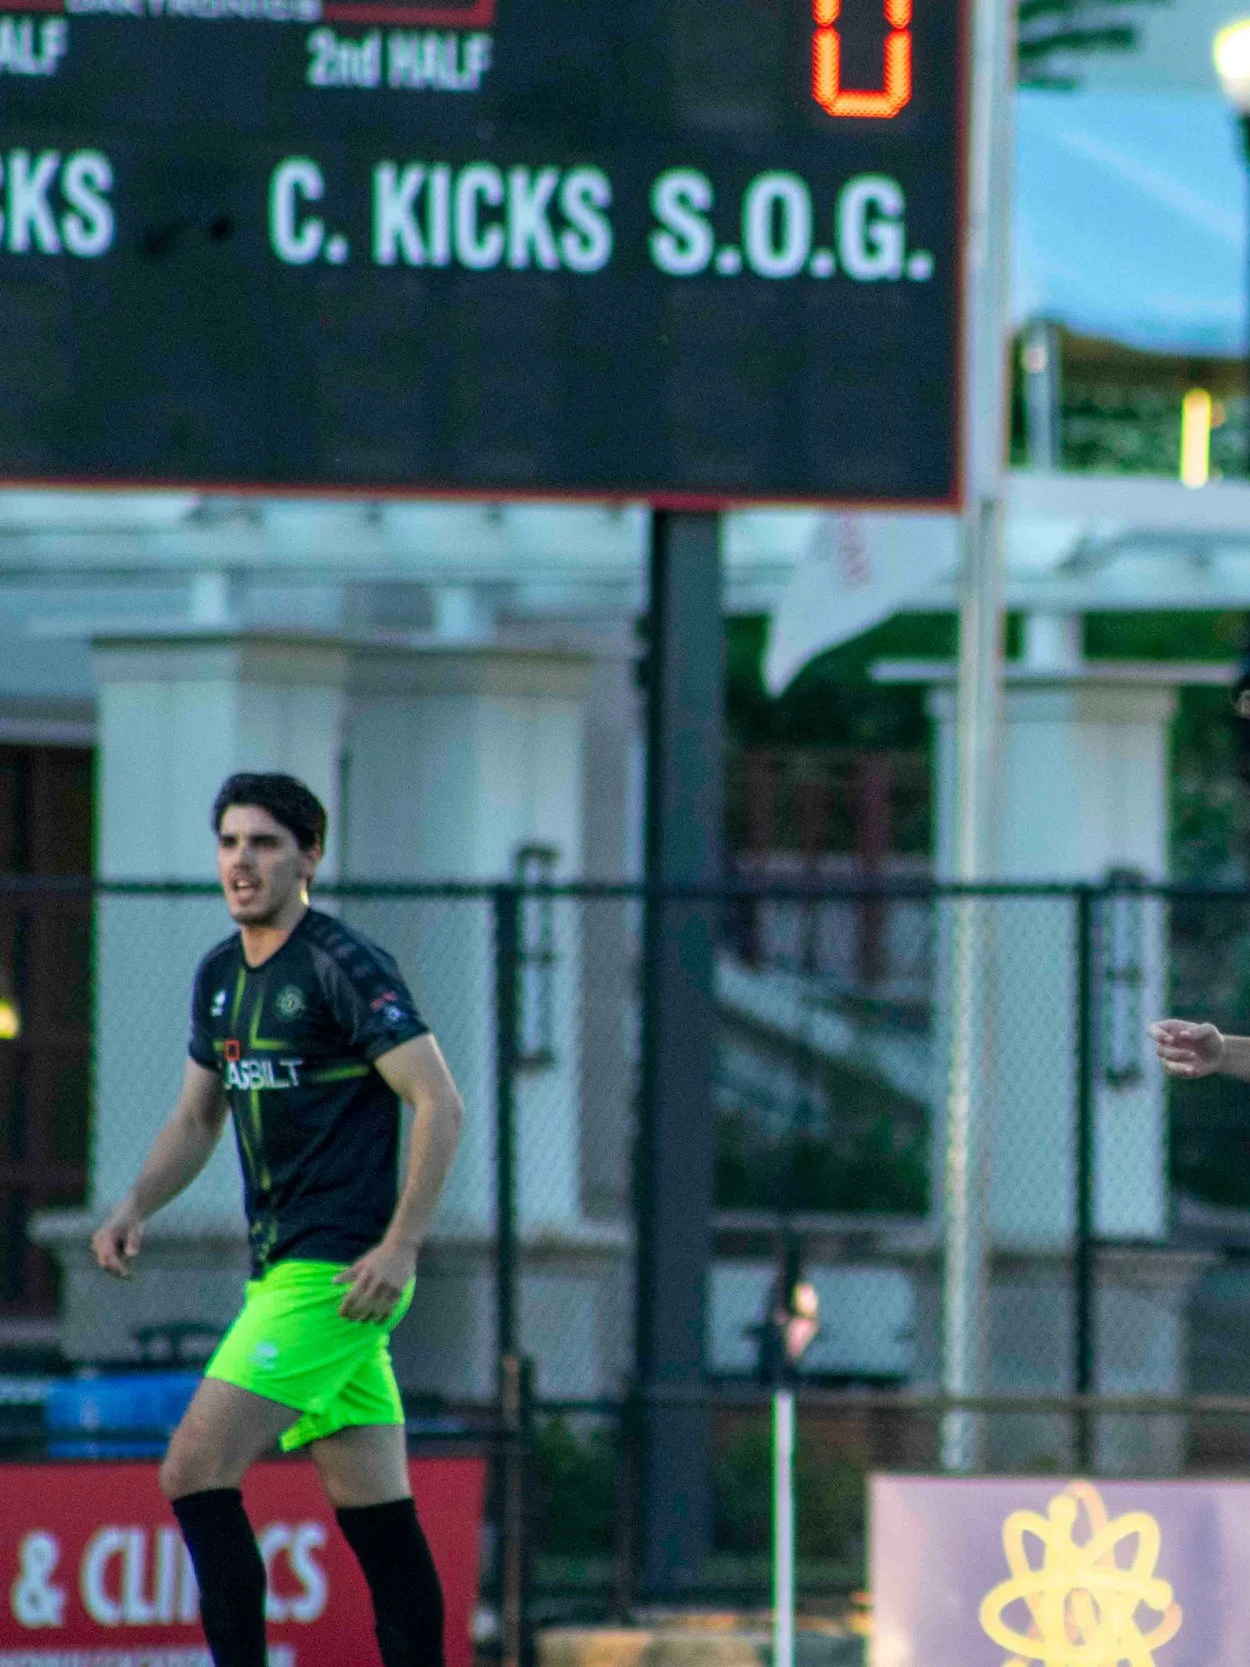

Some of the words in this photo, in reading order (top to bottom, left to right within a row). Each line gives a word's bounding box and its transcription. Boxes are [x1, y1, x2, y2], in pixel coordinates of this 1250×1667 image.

[307, 28, 378, 88] 2nd
[388, 34, 491, 92] HALF
[0, 150, 114, 257] KS
[269, 157, 349, 266] C.
[372, 161, 613, 273] KICKS
[649, 167, 936, 282] S.O.G.
[11, 1530, 65, 1629] &
[80, 1521, 329, 1626] CLICS
